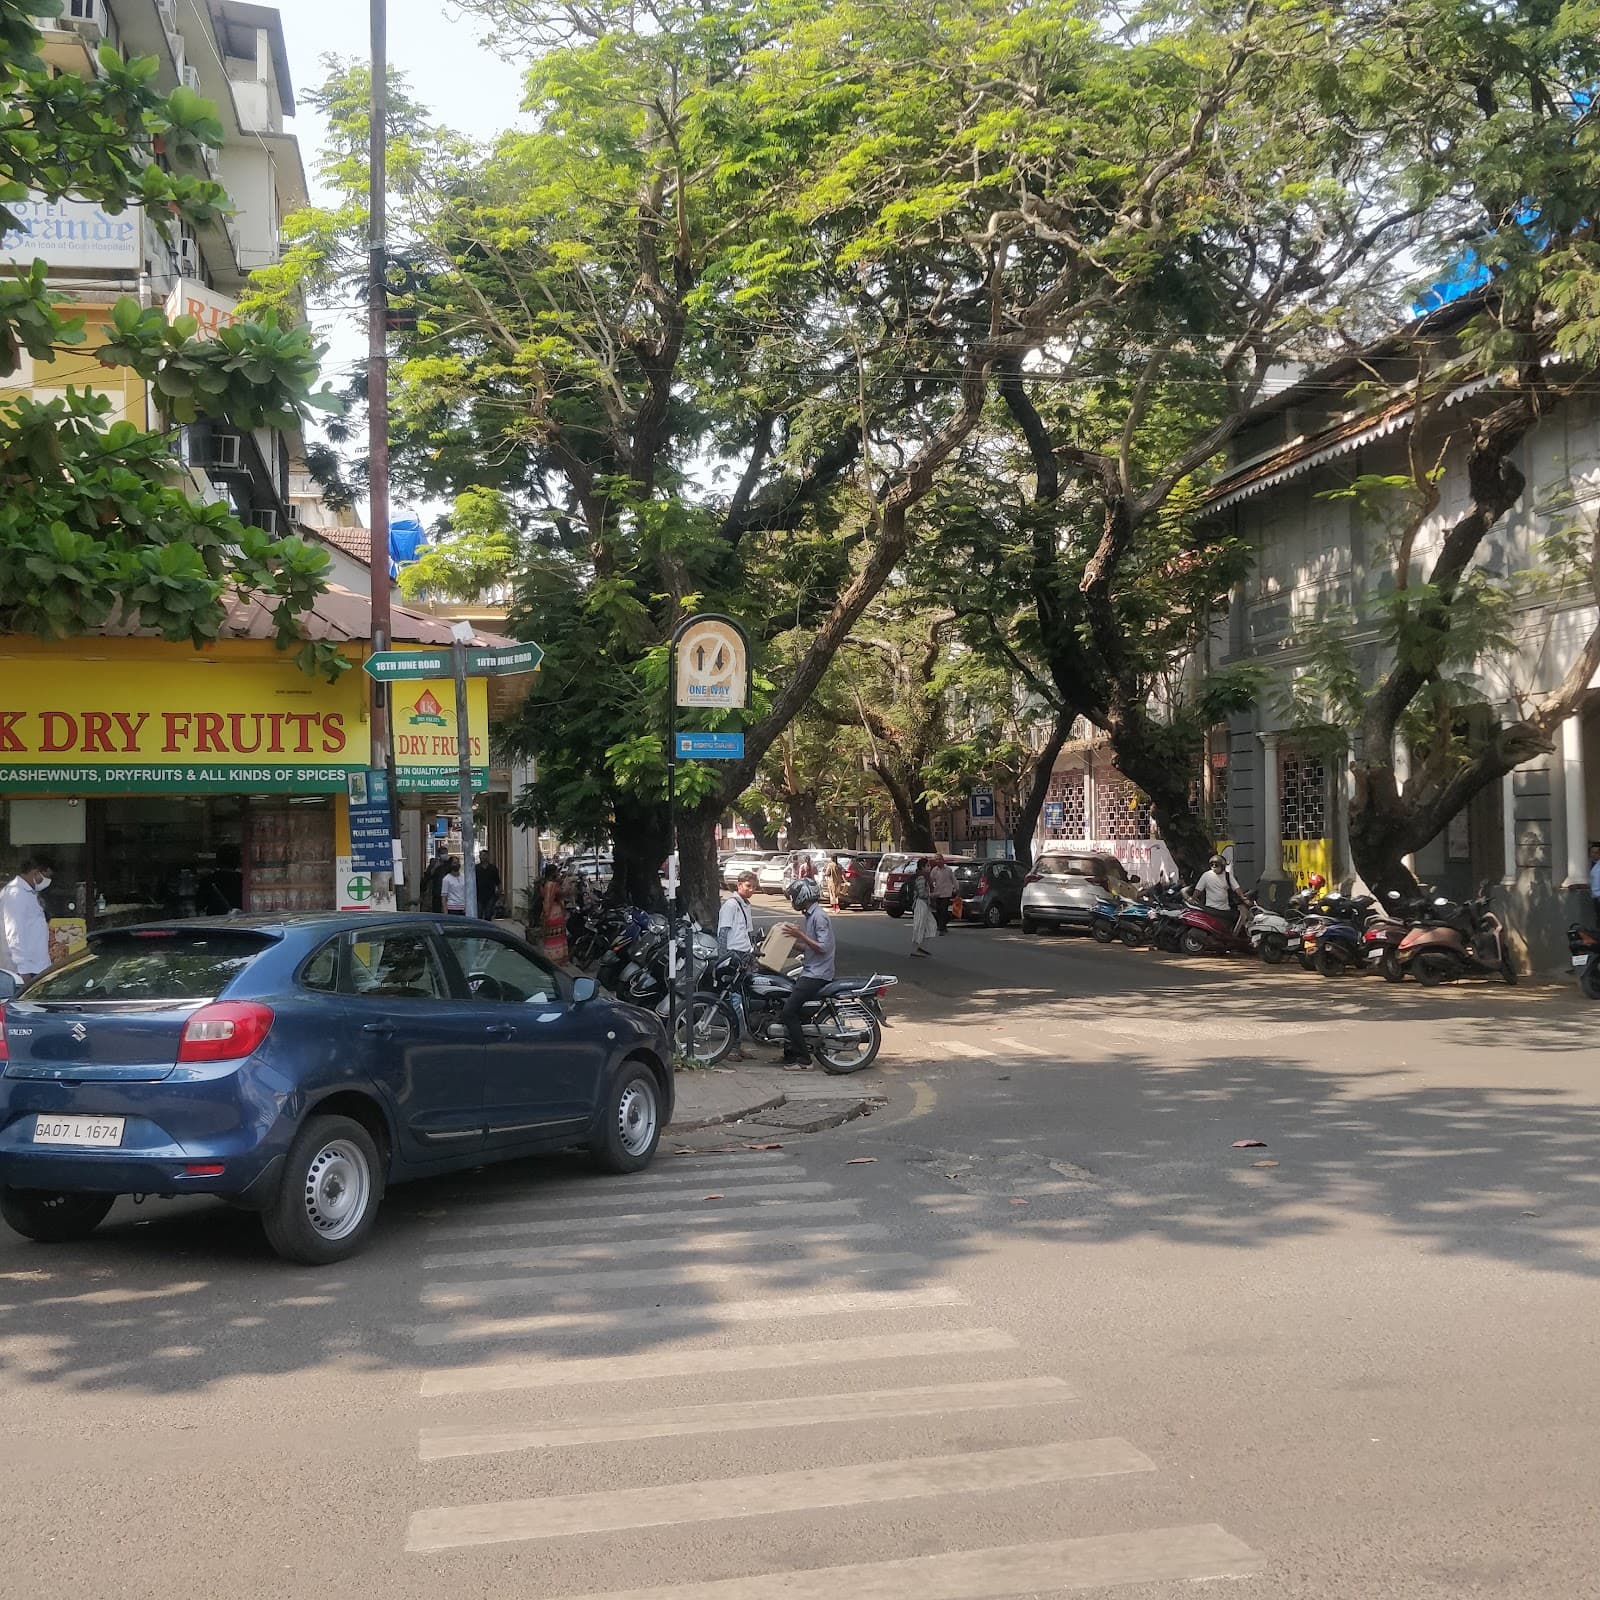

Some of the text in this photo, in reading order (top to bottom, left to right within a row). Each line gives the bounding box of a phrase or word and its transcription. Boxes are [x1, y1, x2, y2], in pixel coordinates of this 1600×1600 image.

[13, 203, 67, 217] OTEL
[58, 241, 66, 249] of
[187, 297, 242, 339] RIT
[397, 660, 418, 670] JUNE
[418, 660, 441, 669] ROAD
[496, 655, 514, 666] JUNE
[514, 652, 532, 664] ROAD
[689, 684, 730, 695] ONE WAY
[38, 711, 150, 753] DRY
[161, 711, 346, 754] FRUITS
[398, 735, 481, 757] DRY FRUTS
[0, 769, 346, 783] CASHEWNUTS, DRYFRUITS & ALL KINDS OF SPICES
[411, 767, 439, 775] QUALITY
